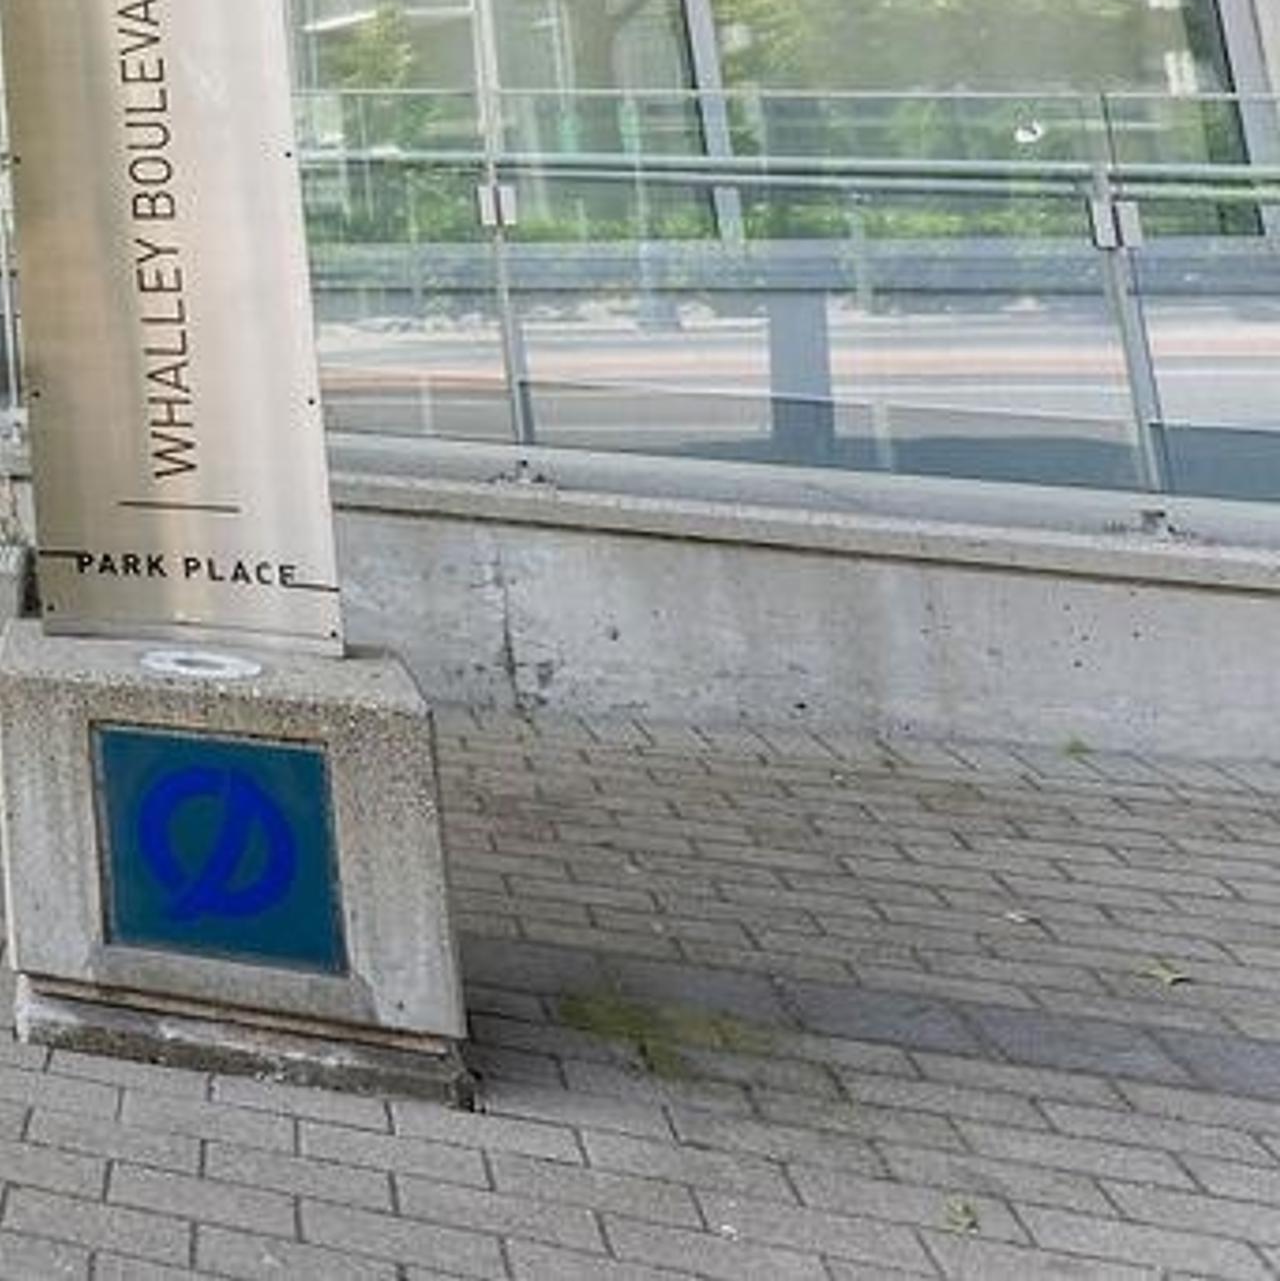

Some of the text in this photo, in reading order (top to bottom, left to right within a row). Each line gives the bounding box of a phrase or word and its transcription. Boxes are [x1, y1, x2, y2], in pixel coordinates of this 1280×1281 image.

[137, 237, 199, 480] WHALLEY
[75, 551, 297, 587] PARK PLACE
